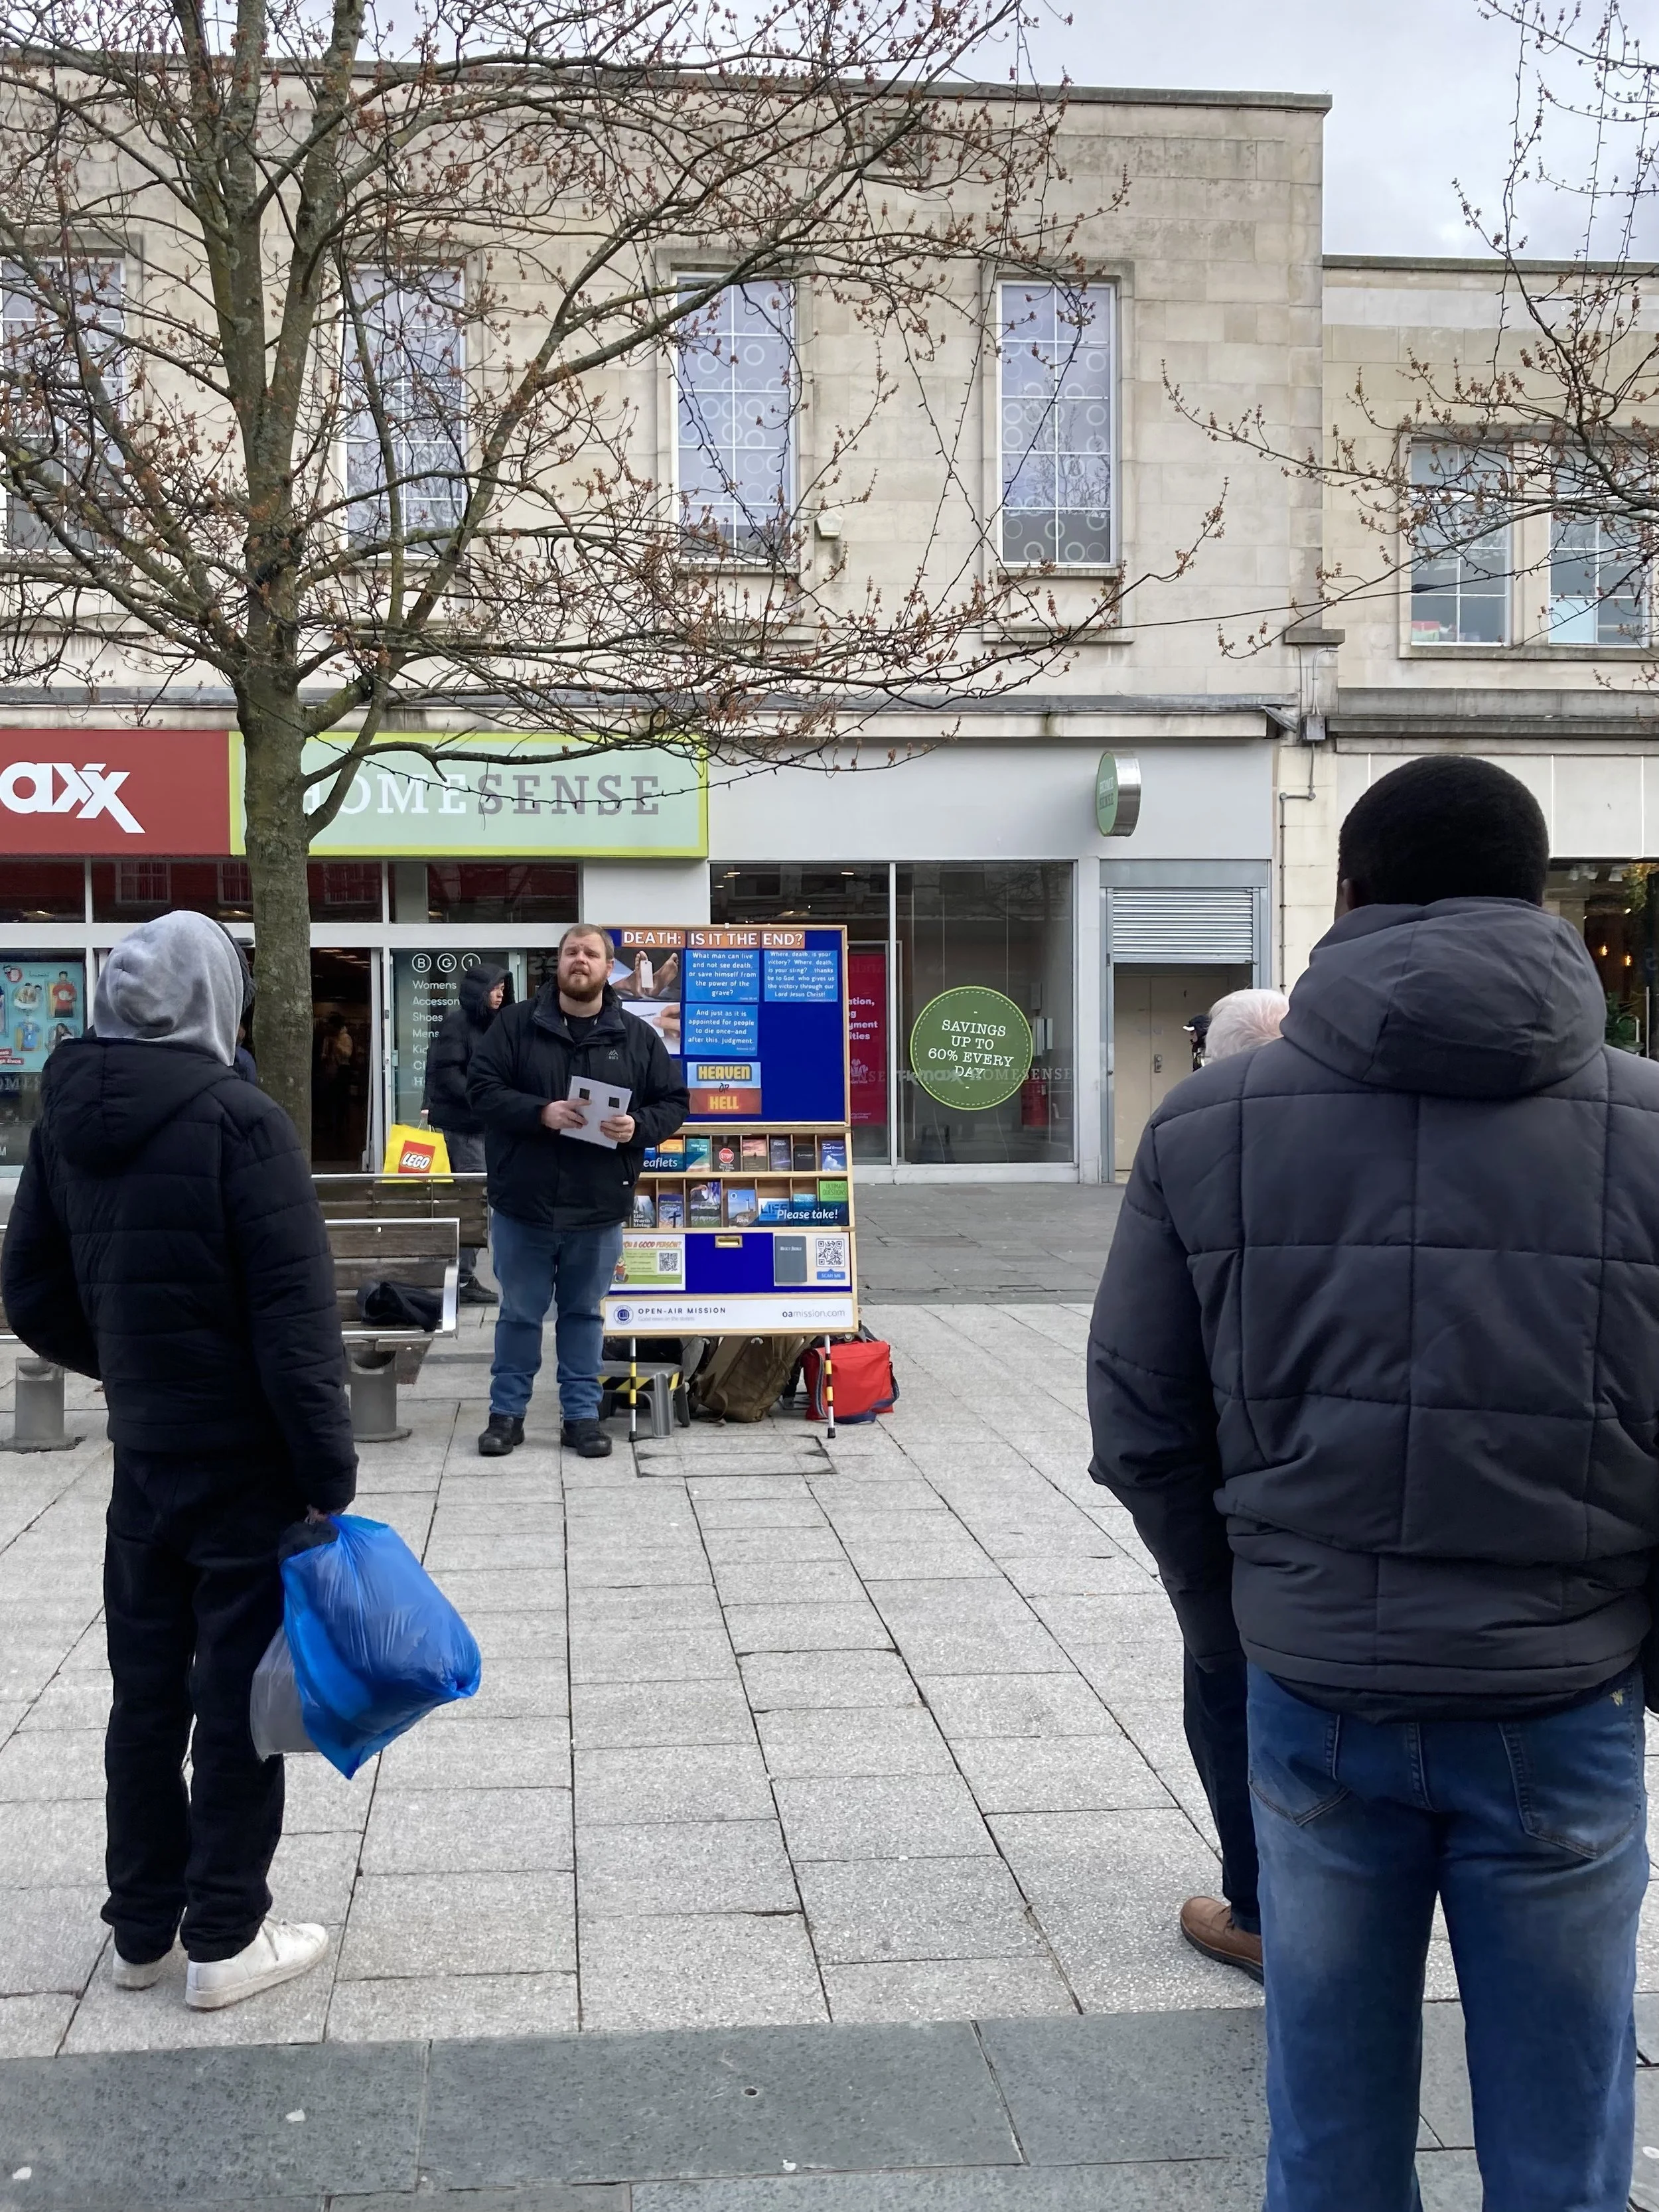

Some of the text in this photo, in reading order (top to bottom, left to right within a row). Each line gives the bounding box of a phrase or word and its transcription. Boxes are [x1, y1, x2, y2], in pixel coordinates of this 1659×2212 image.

[623, 931, 803, 946] DEATH: IS IT THE END?
[417, 958, 426, 968] B
[441, 958, 453, 968] G
[413, 980, 457, 990] Womens
[413, 1012, 443, 1022] Shoes
[413, 1028, 439, 1038] Mens
[942, 1019, 1006, 1037] SAVINGS
[951, 1035, 994, 1050] UP TO
[928, 1048, 1014, 1067] 60% EVERY
[698, 1065, 751, 1080] HEAVEN
[954, 1065, 985, 1079] DAY
[709, 1096, 739, 1110] HELL
[402, 1152, 431, 1169] LEGO
[643, 1157, 678, 1169] eaflets
[777, 1209, 838, 1219] Please take!
[782, 1309, 845, 1317] oamission.com
